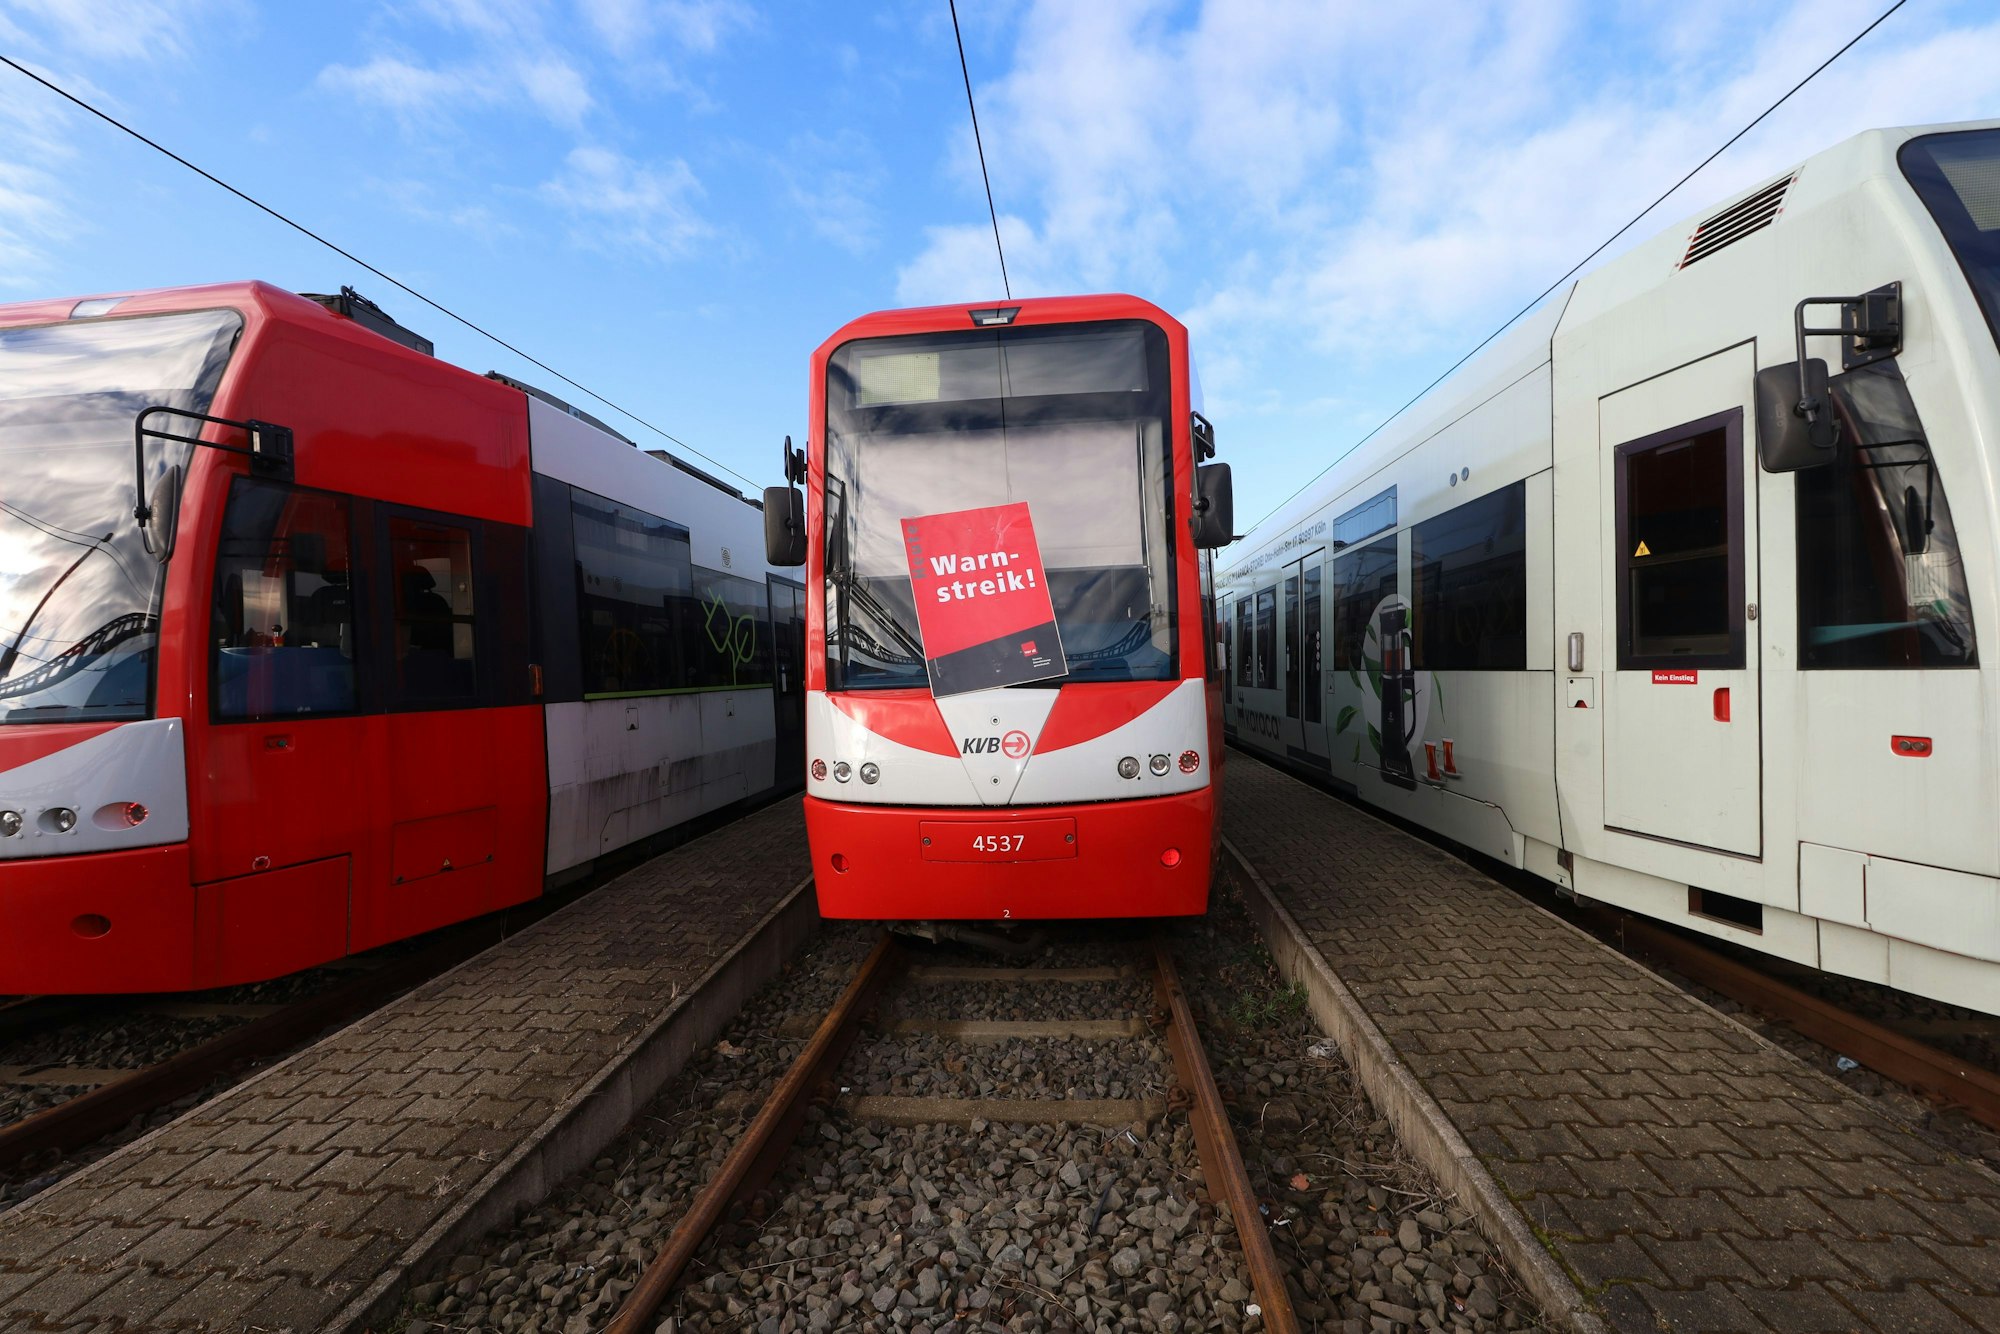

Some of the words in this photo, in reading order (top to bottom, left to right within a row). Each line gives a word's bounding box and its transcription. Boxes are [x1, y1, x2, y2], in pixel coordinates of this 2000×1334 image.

[1315, 520, 1326, 536] Köln
[930, 550, 1019, 577] Warn-
[936, 568, 1036, 603] streik!
[1670, 674, 1694, 682] Einstieg
[1245, 709, 1279, 741] karaca
[962, 736, 1001, 754] KVB
[972, 834, 1025, 852] 4537
[1003, 909, 1010, 918] 2
